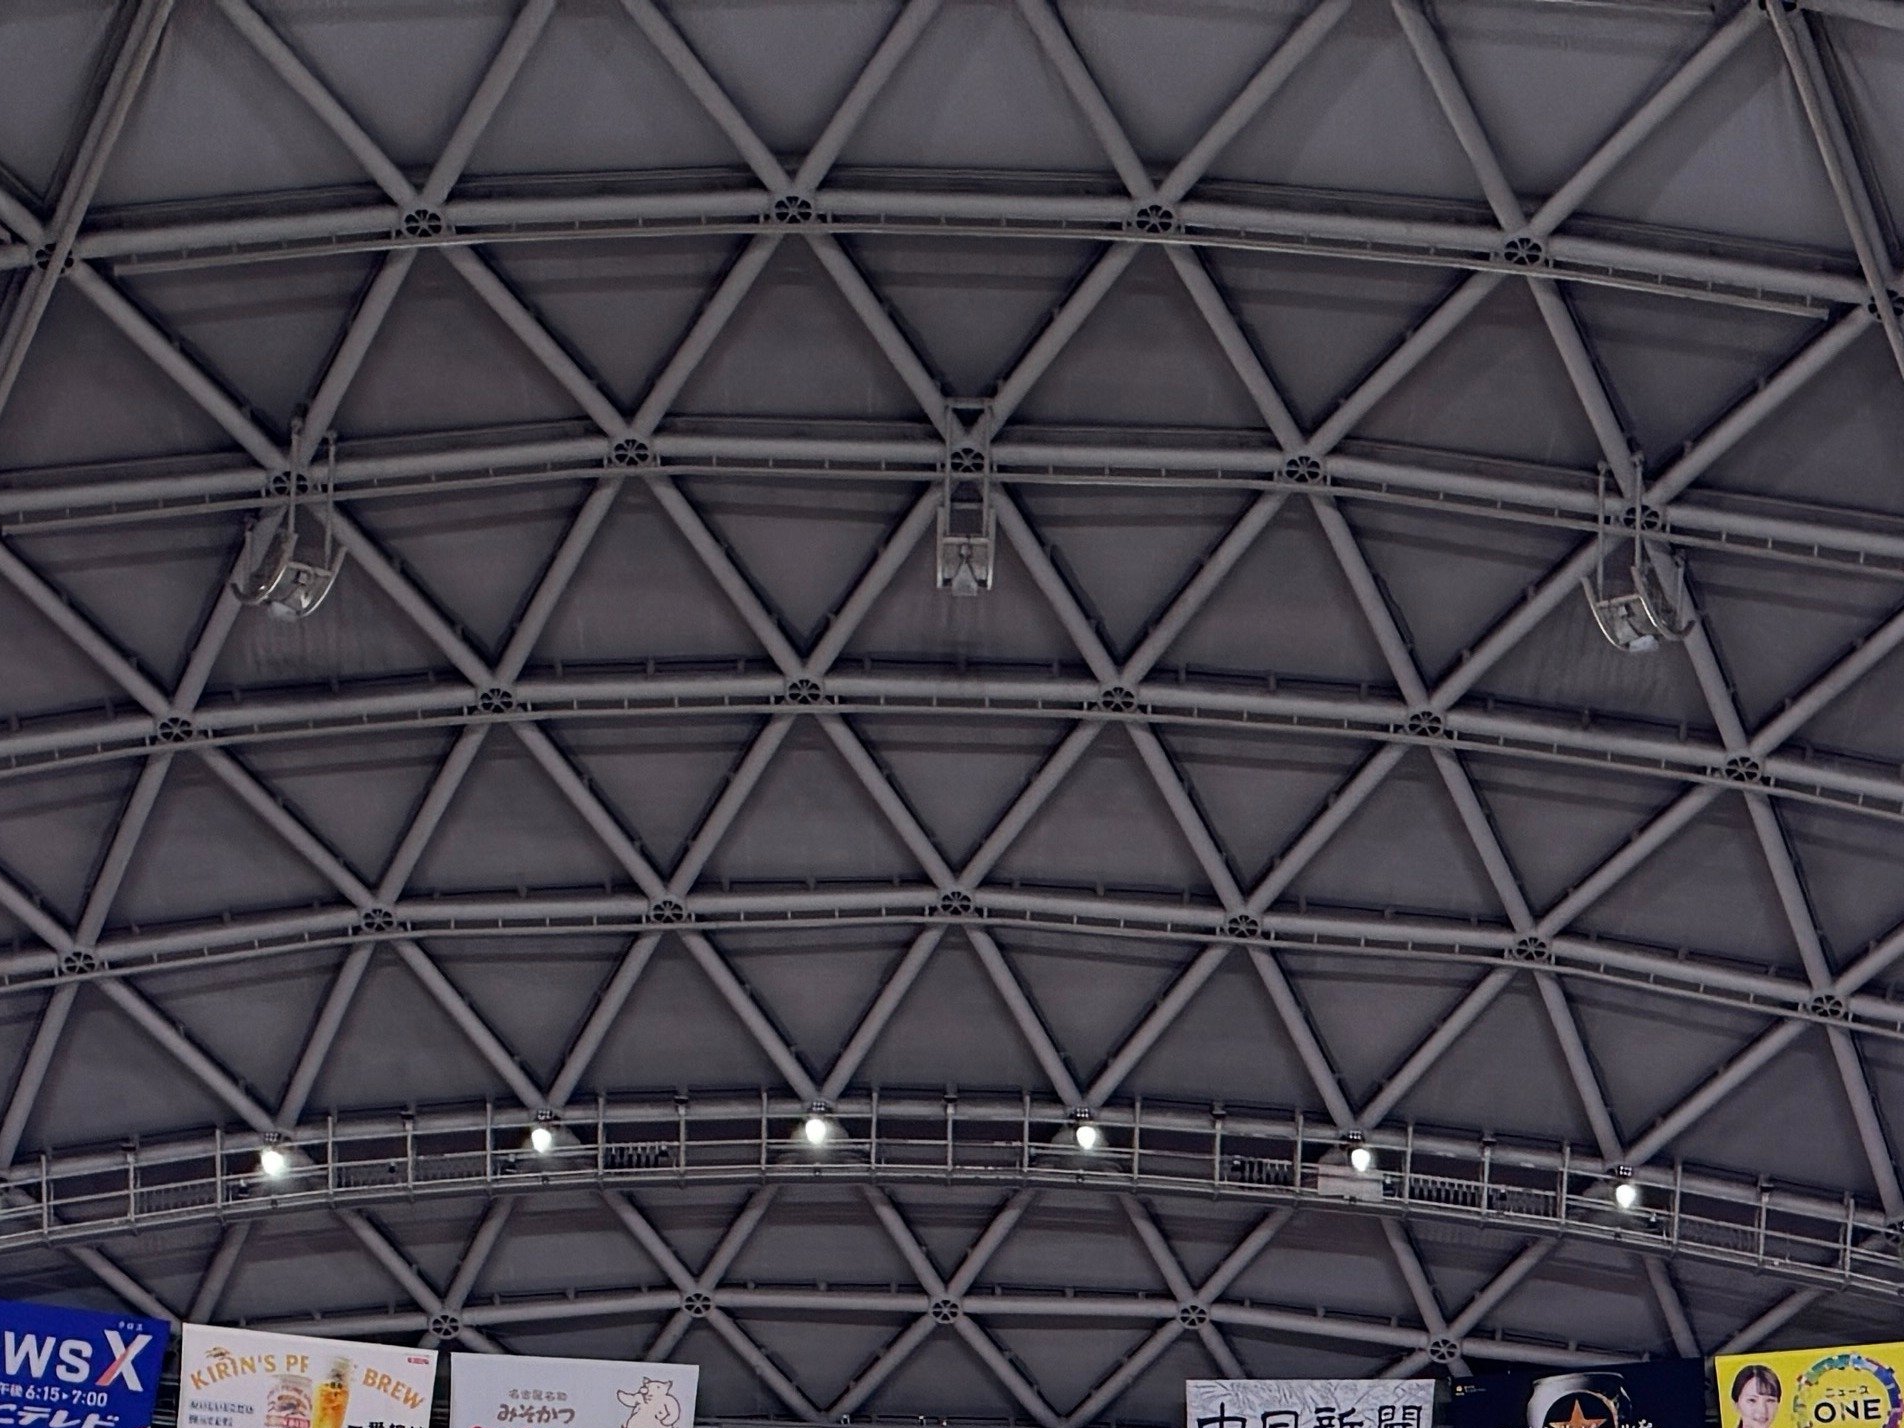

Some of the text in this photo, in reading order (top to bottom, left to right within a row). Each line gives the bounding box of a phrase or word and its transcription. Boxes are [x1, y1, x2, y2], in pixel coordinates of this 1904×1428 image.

[190, 1354, 277, 1391] KIRIN'S
[362, 1367, 426, 1410] BREW
[1825, 1385, 1869, 1398] ニュース
[496, 1403, 576, 1424] みそかつ
[1814, 1398, 1881, 1424] ONE
